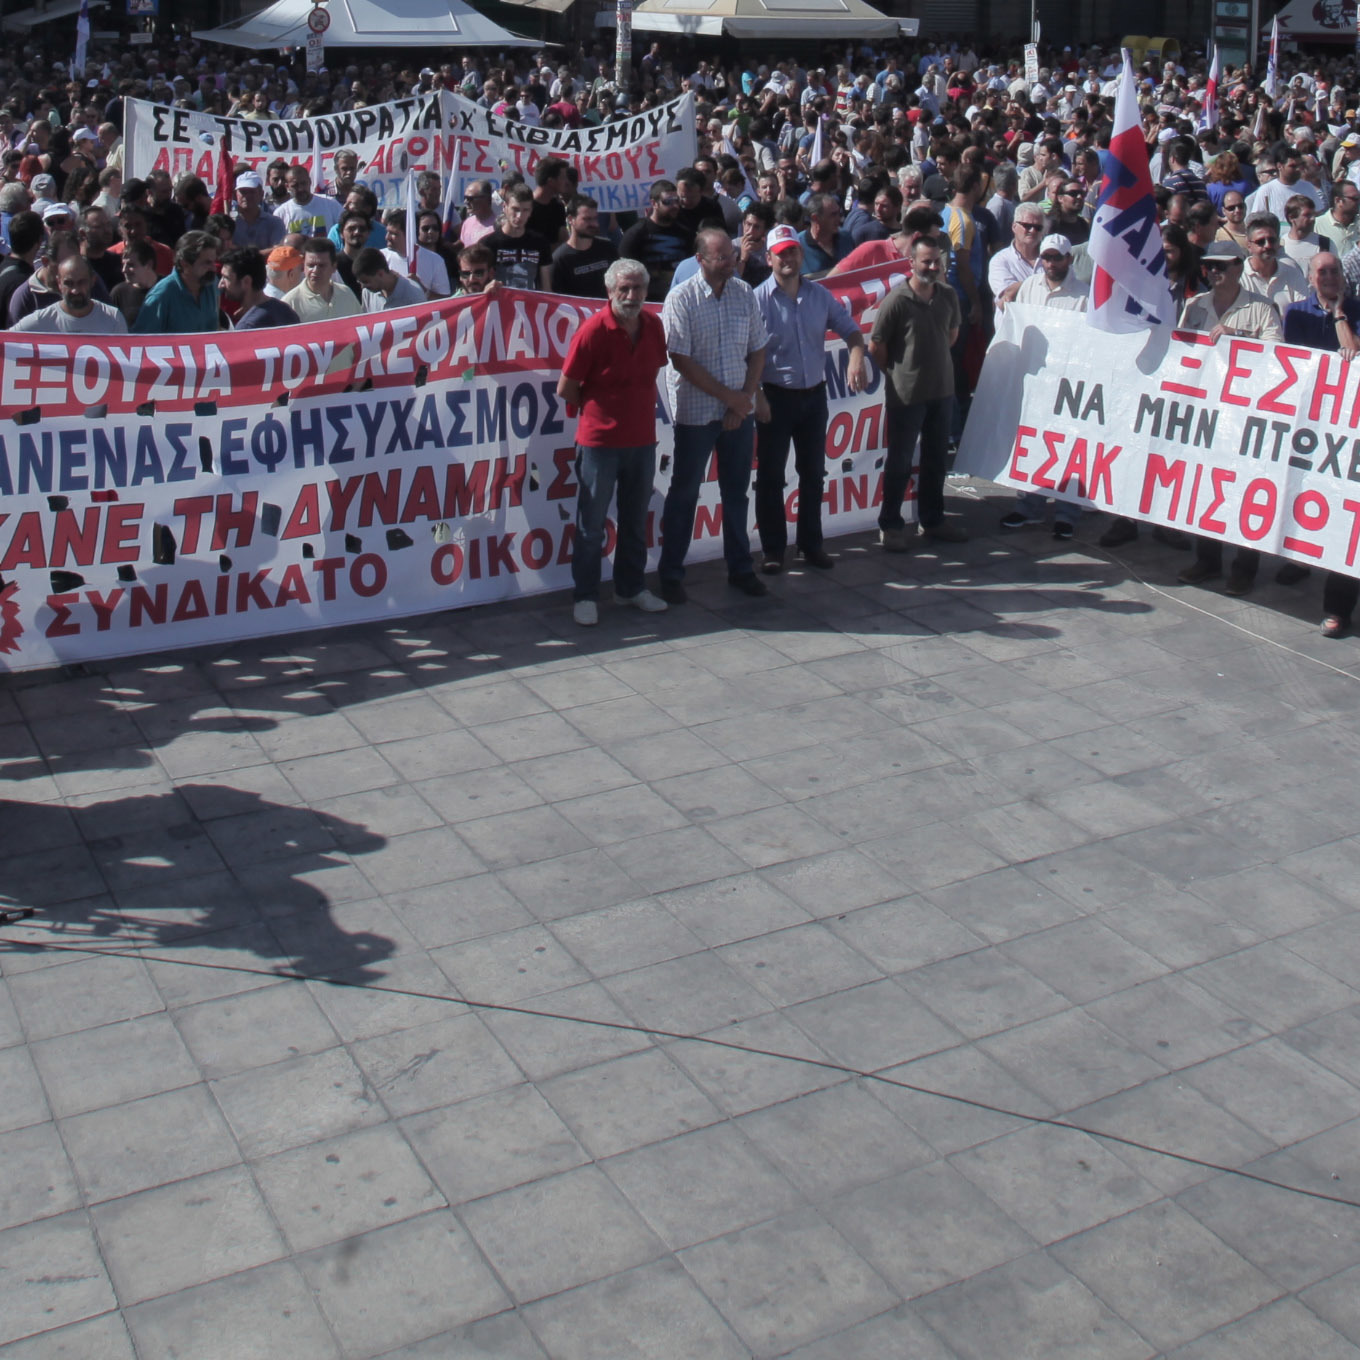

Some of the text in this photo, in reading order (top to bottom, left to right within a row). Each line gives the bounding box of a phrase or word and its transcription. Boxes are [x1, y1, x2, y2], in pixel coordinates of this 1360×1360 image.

[153, 106, 191, 143] ΣΕ
[214, 93, 442, 152] ΤΡΟΜΟΚΡΑΤΙΑ
[0, 341, 232, 407] ΕΞΟΥΣΙΑ
[254, 340, 336, 393] ΤΟΥ
[1053, 377, 1106, 426] ΝΑ
[1134, 393, 1220, 450] ΜΗΝ
[221, 381, 565, 477] ΕΦΗΣΥΧΑΣΜΟΣ
[1008, 425, 1124, 506] ΕΣΑΚ
[173, 490, 259, 555] ΤΗ
[280, 453, 528, 541] ΔΥΝΑΜΗ
[45, 552, 389, 640] ΣΥΝΔΙΚΑΤΟ
